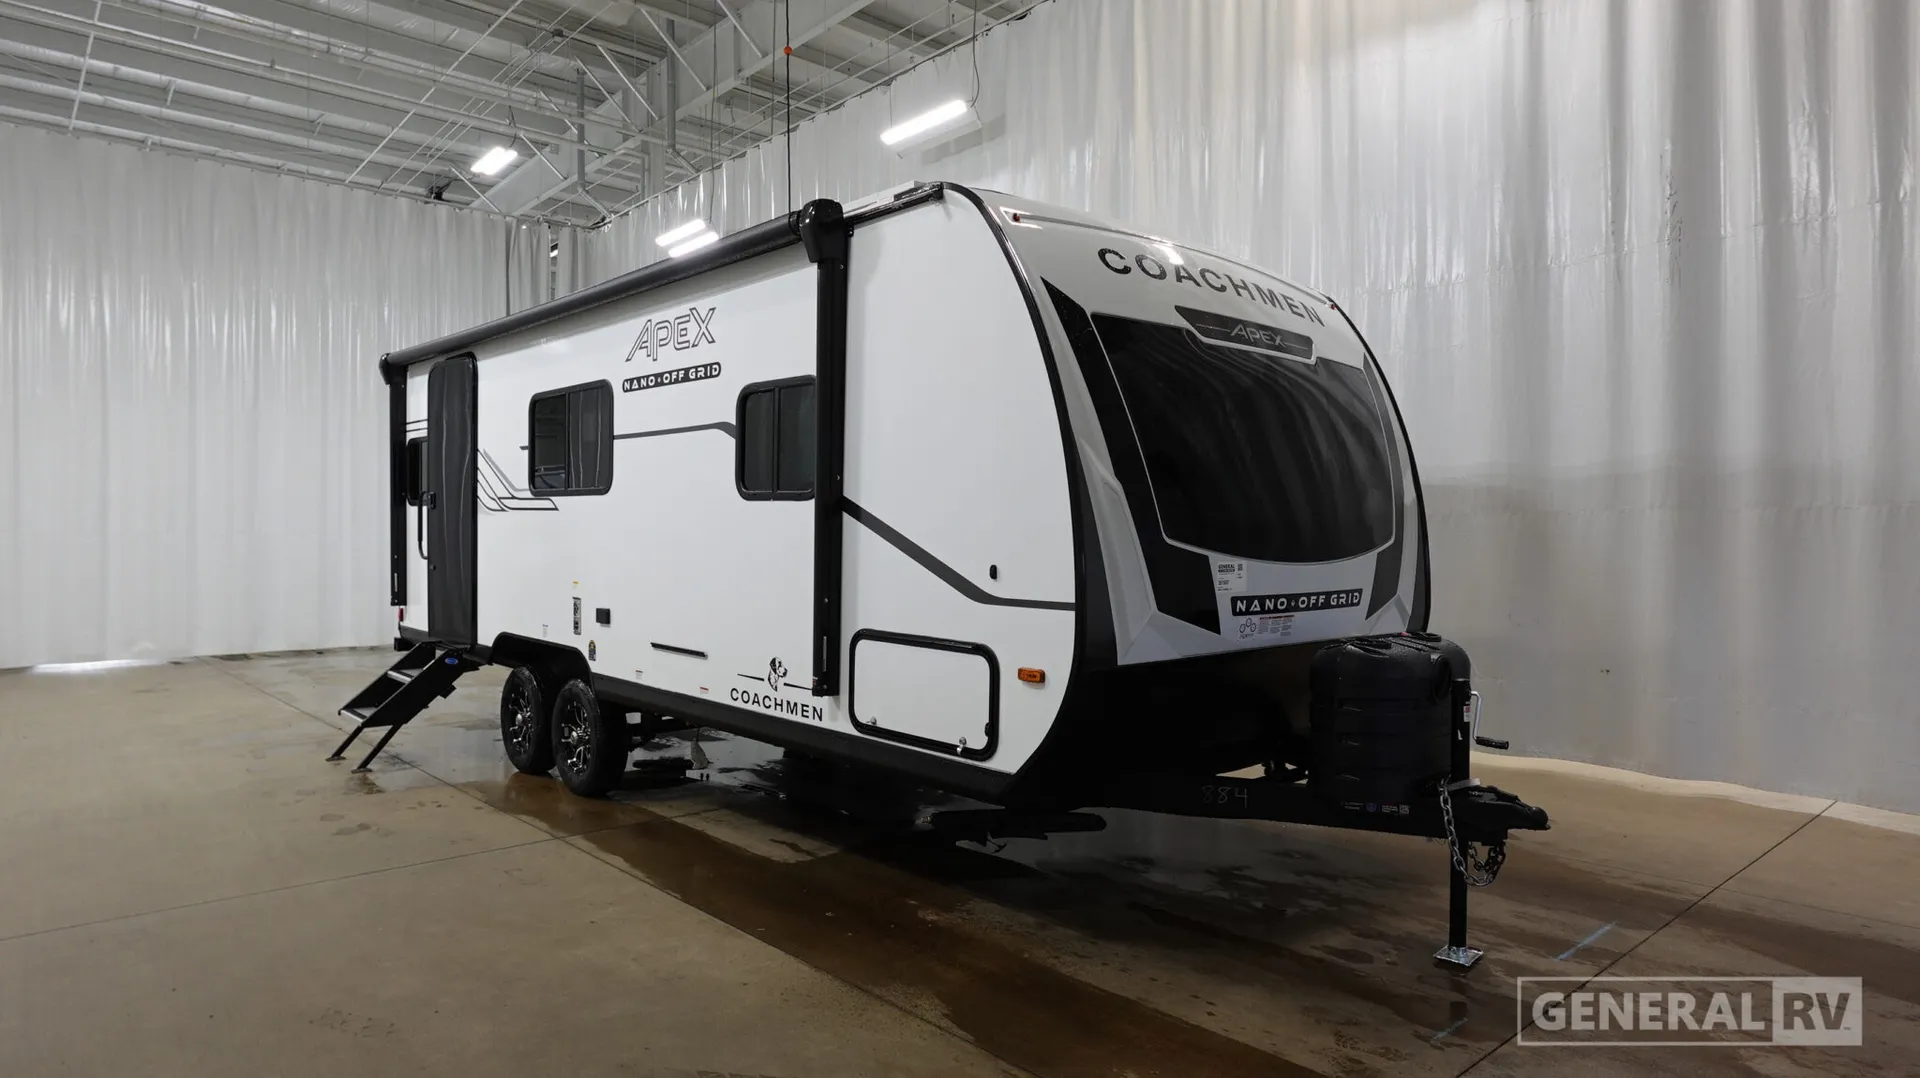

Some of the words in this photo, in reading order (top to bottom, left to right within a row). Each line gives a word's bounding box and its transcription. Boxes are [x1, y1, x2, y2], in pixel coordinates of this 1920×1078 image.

[1097, 248, 1326, 327] COACHMEN
[624, 306, 717, 362] APEX
[1230, 323, 1287, 348] APEX
[662, 370, 685, 384] OFF
[688, 364, 720, 379] GRID
[1298, 595, 1326, 608] OFF
[1330, 592, 1360, 606] GRID
[730, 687, 823, 722] COACHMEN
[1202, 785, 1248, 810] 884
